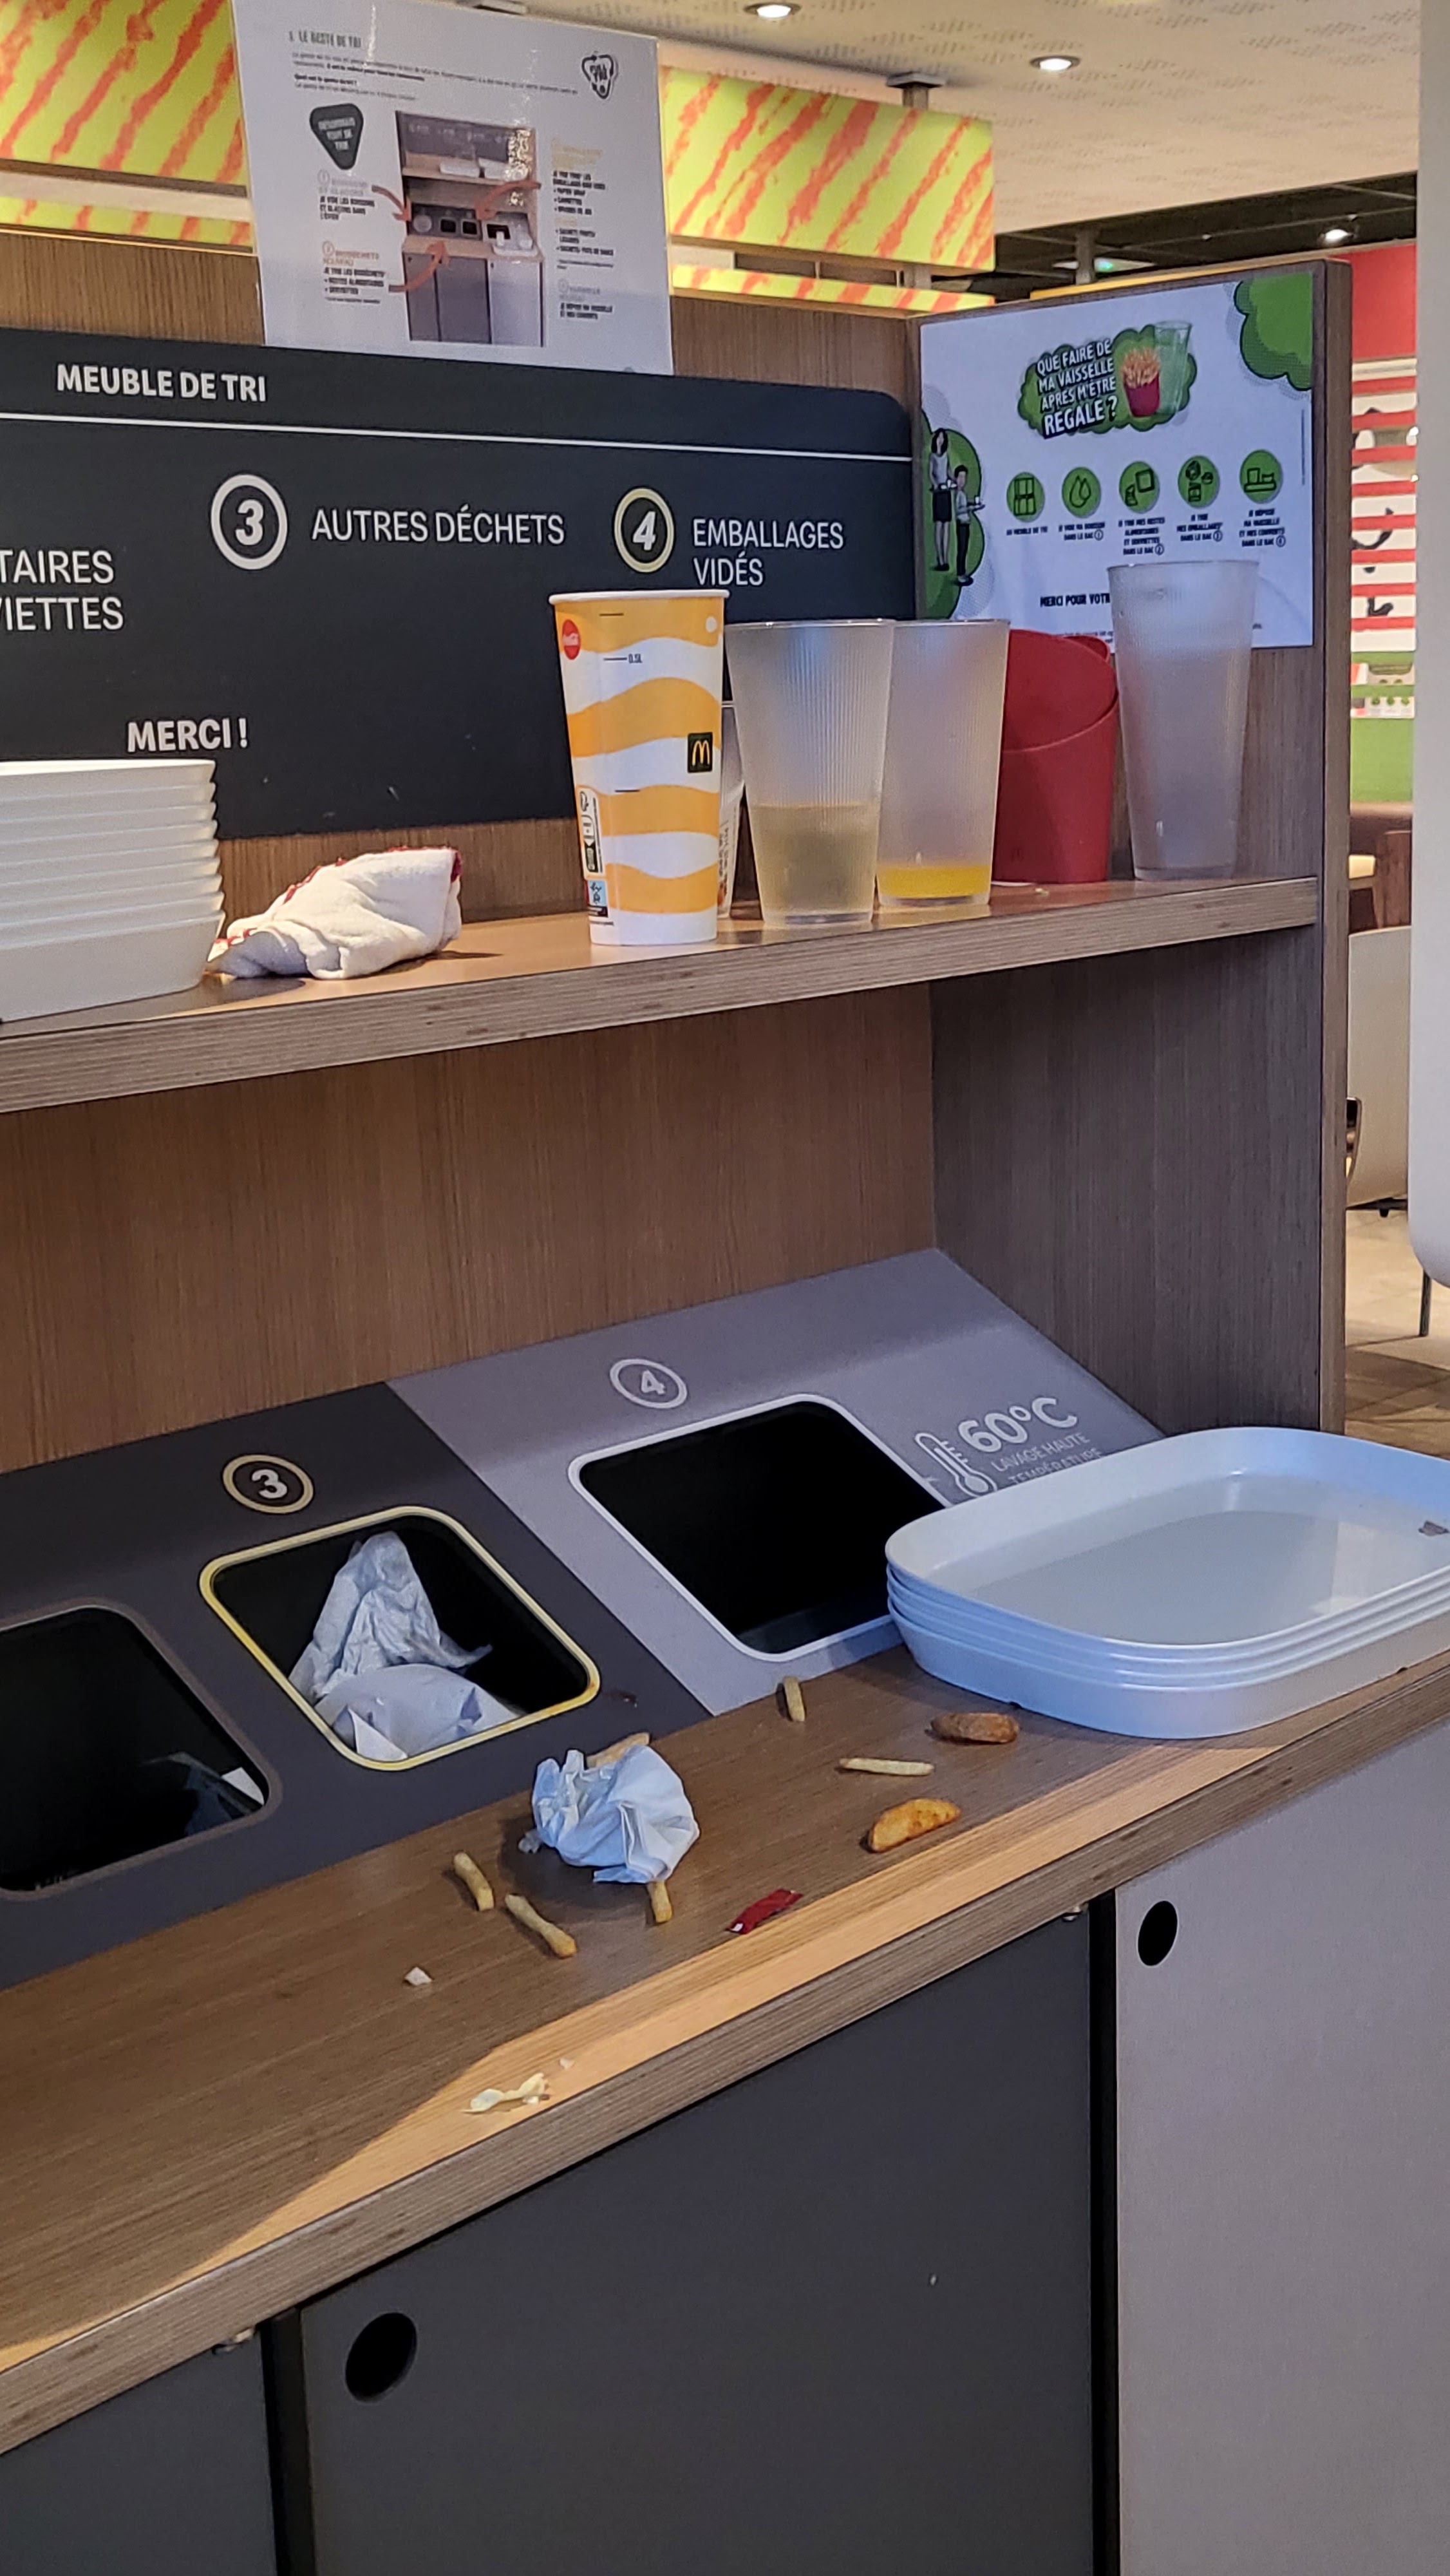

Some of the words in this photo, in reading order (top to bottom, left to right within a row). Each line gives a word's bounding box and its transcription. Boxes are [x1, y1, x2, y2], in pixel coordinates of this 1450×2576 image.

[1037, 355, 1060, 377] QUE
[1062, 345, 1094, 367] FAIRE
[1097, 339, 1113, 357] DE
[1039, 377, 1056, 393] MA
[1058, 357, 1115, 387] VAISSELLE
[57, 363, 174, 398] MEUBLE
[180, 371, 217, 400] DE
[220, 374, 267, 402] TRI
[234, 498, 265, 546] 3
[311, 509, 428, 542] AUTRES
[435, 504, 565, 545] DÉCHETS
[632, 510, 657, 550] 4
[693, 518, 844, 549] EMBALLAGES
[0, 549, 115, 584] TAIRES
[693, 551, 764, 586] VIDÉS
[0, 596, 124, 631] IETTES
[1040, 595, 1064, 607] MERCI
[1065, 594, 1087, 606] POUR
[1089, 592, 1110, 604] VOTR
[127, 718, 232, 753] MERCI
[640, 1370, 666, 1395] 4
[957, 1396, 1078, 1453] 60°C
[990, 1445, 1048, 1472] LAVAGE
[1040, 1432, 1091, 1455] HAUTE
[251, 1468, 289, 1500] 3
